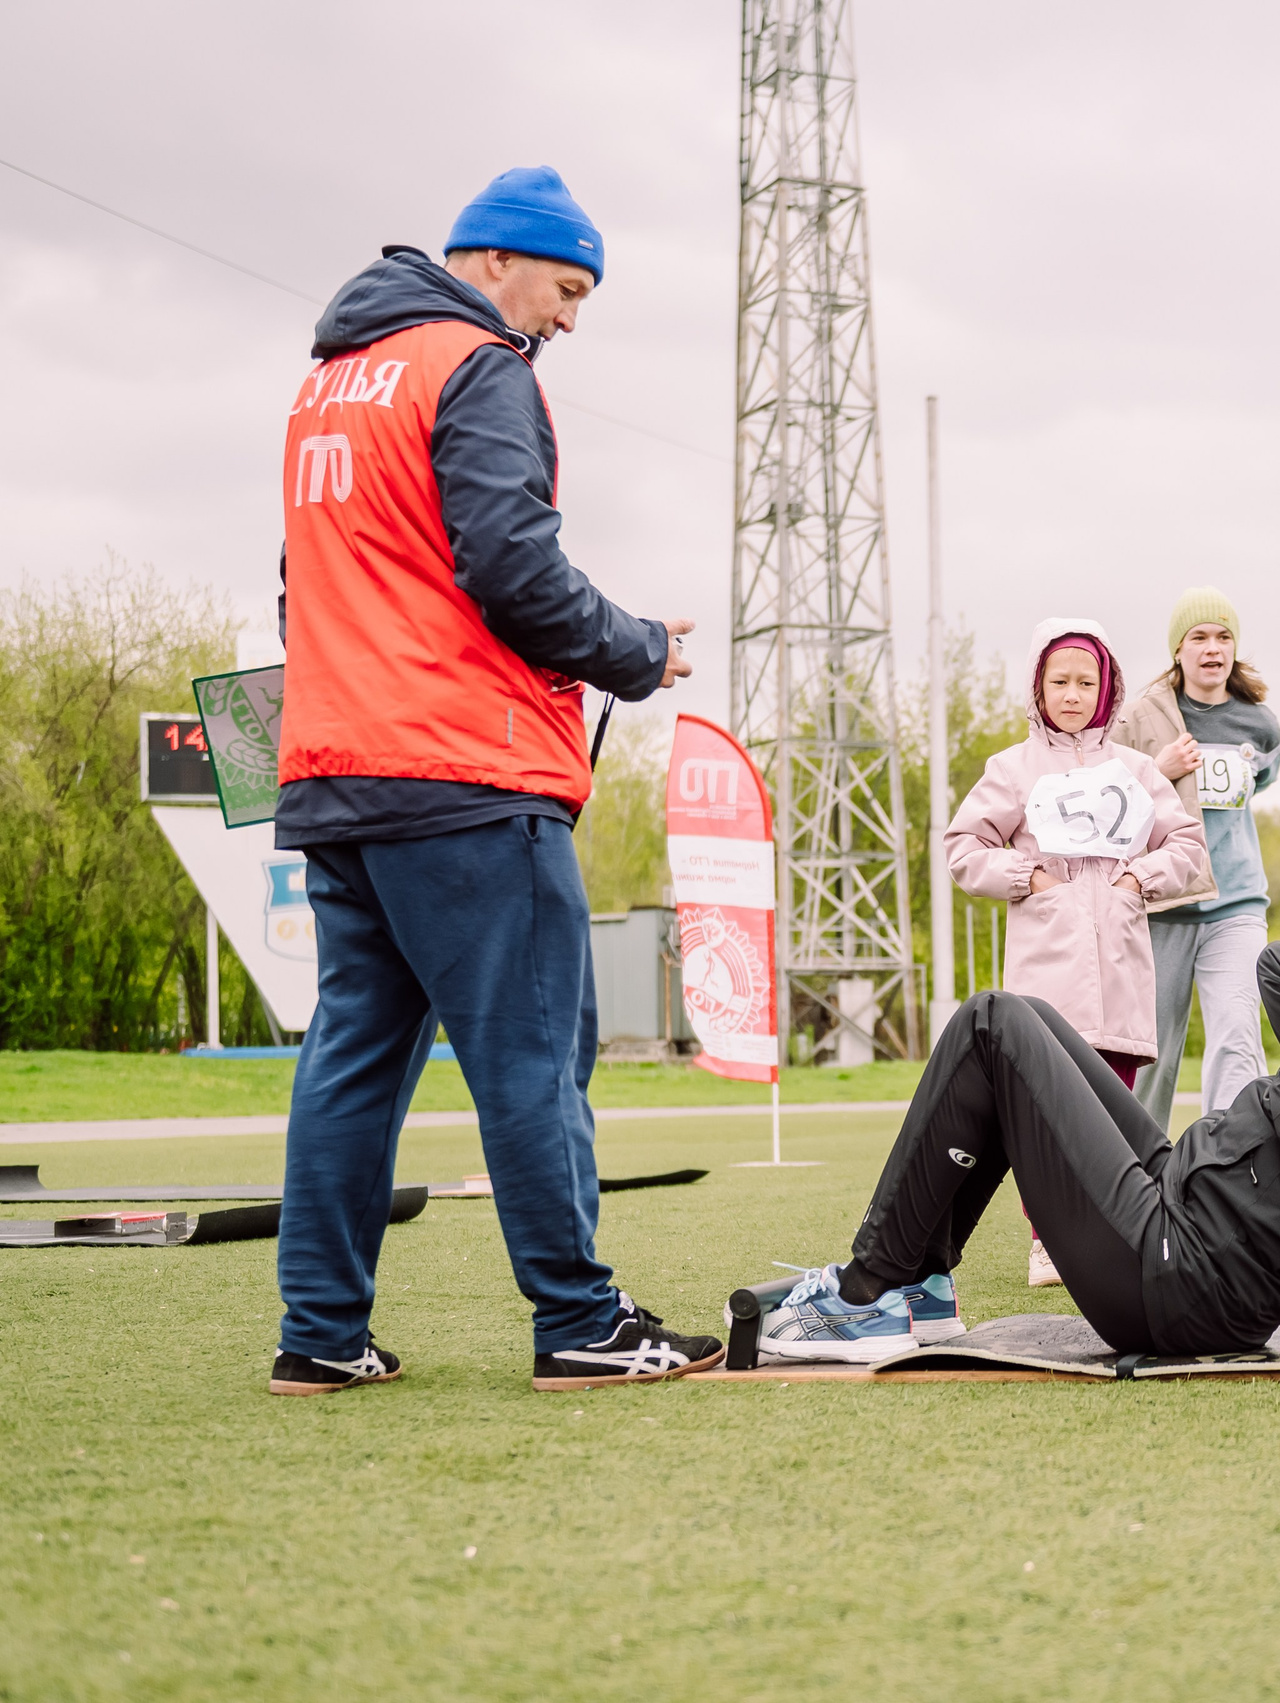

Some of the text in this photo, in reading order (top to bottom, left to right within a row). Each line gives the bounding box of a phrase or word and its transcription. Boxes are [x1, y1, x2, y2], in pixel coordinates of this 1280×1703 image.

[295, 434, 353, 507] ГТО
[232, 699, 264, 738] ГТО
[1199, 757, 1232, 793] 19
[1055, 785, 1131, 844] 52
